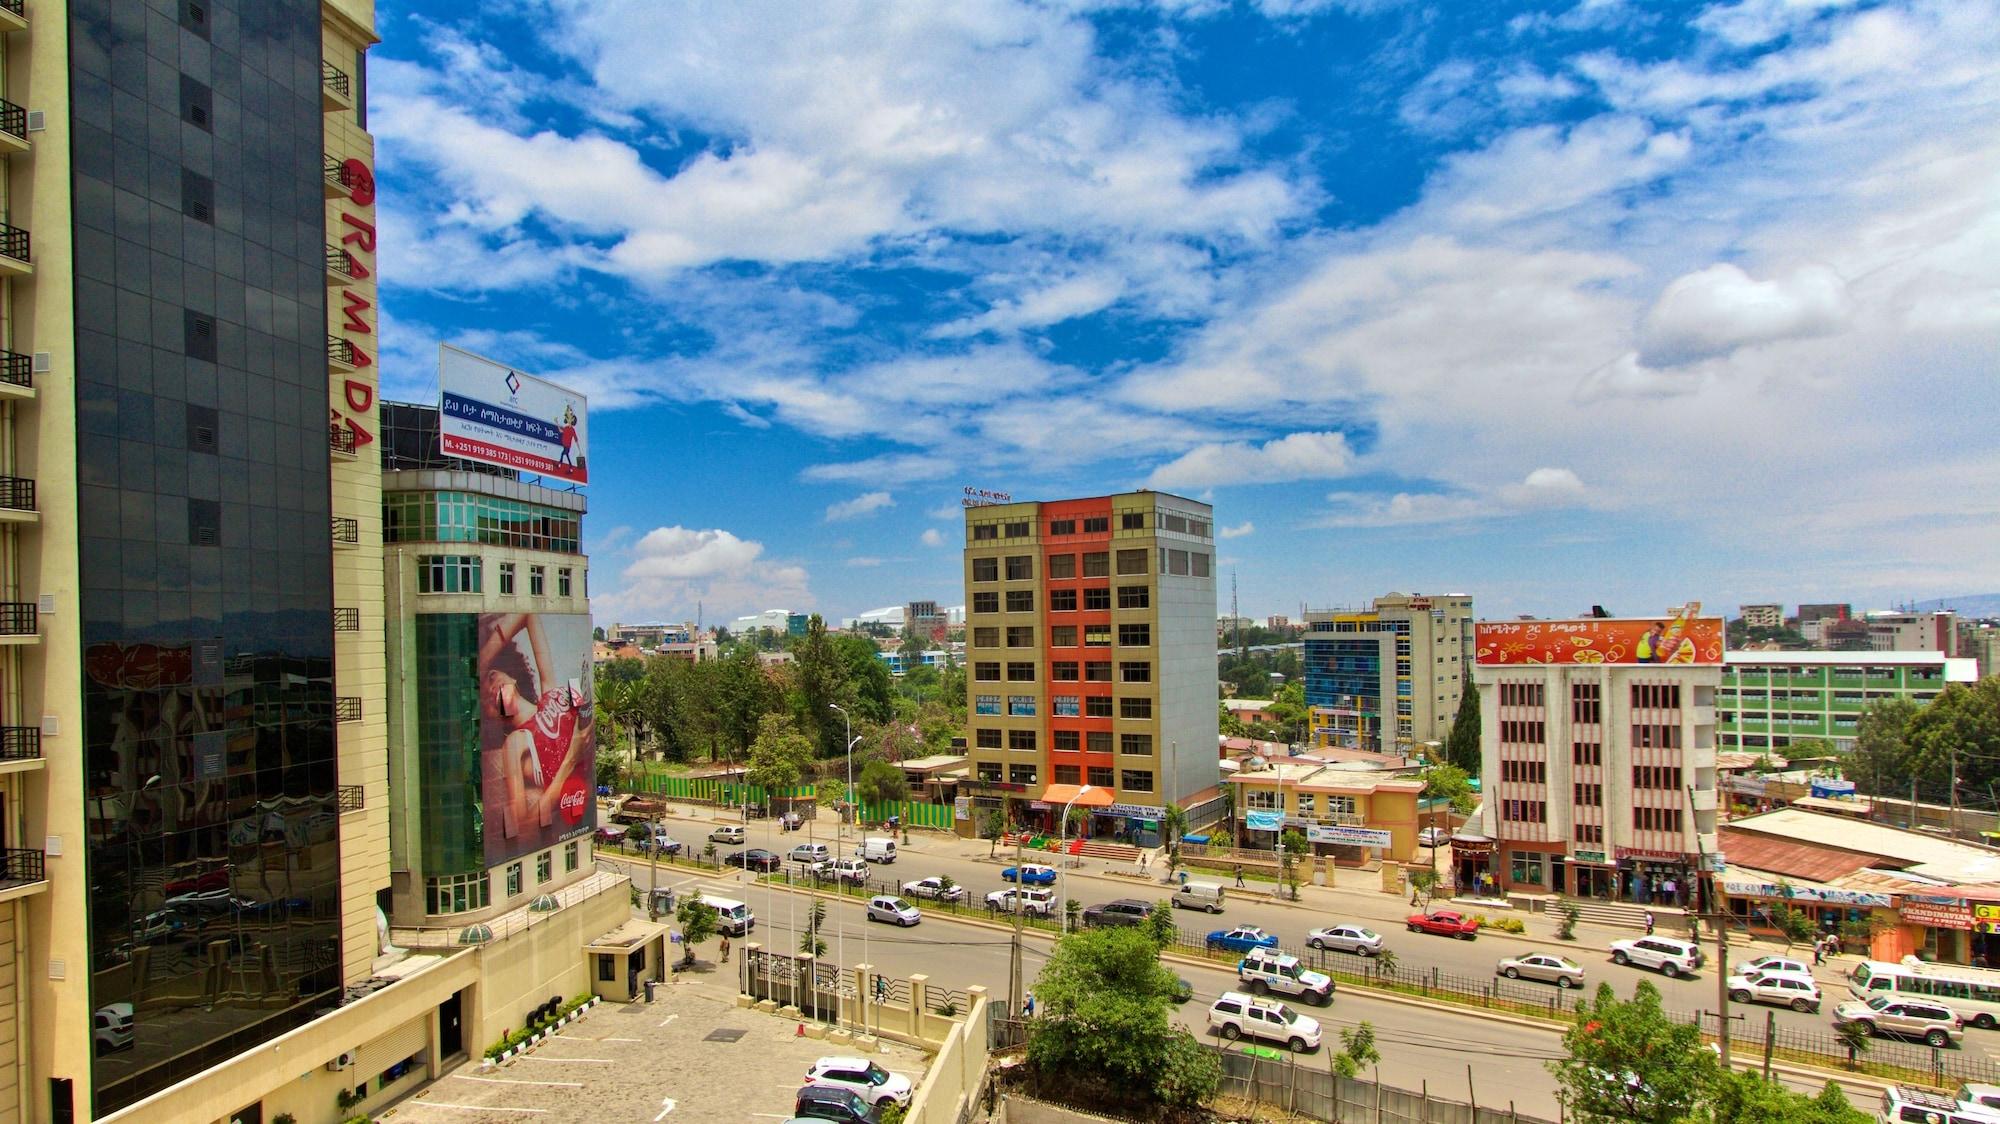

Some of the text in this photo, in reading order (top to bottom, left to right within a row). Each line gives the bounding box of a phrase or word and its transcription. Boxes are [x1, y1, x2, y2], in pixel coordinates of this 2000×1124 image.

[342, 212, 377, 448] RAMADA
[445, 399, 459, 411] ይህ
[462, 404, 476, 414] ቦታ
[481, 410, 523, 429] ለማስታወቂያ
[525, 418, 542, 434] ክፍት
[444, 439, 455, 450] M.
[455, 441, 472, 452] +251
[472, 445, 485, 455] 919
[485, 447, 497, 458] 385
[498, 450, 508, 461] 173
[512, 454, 525, 465] +251
[560, 789, 586, 810] Coca-Cola
[1266, 976, 1278, 985] UN
